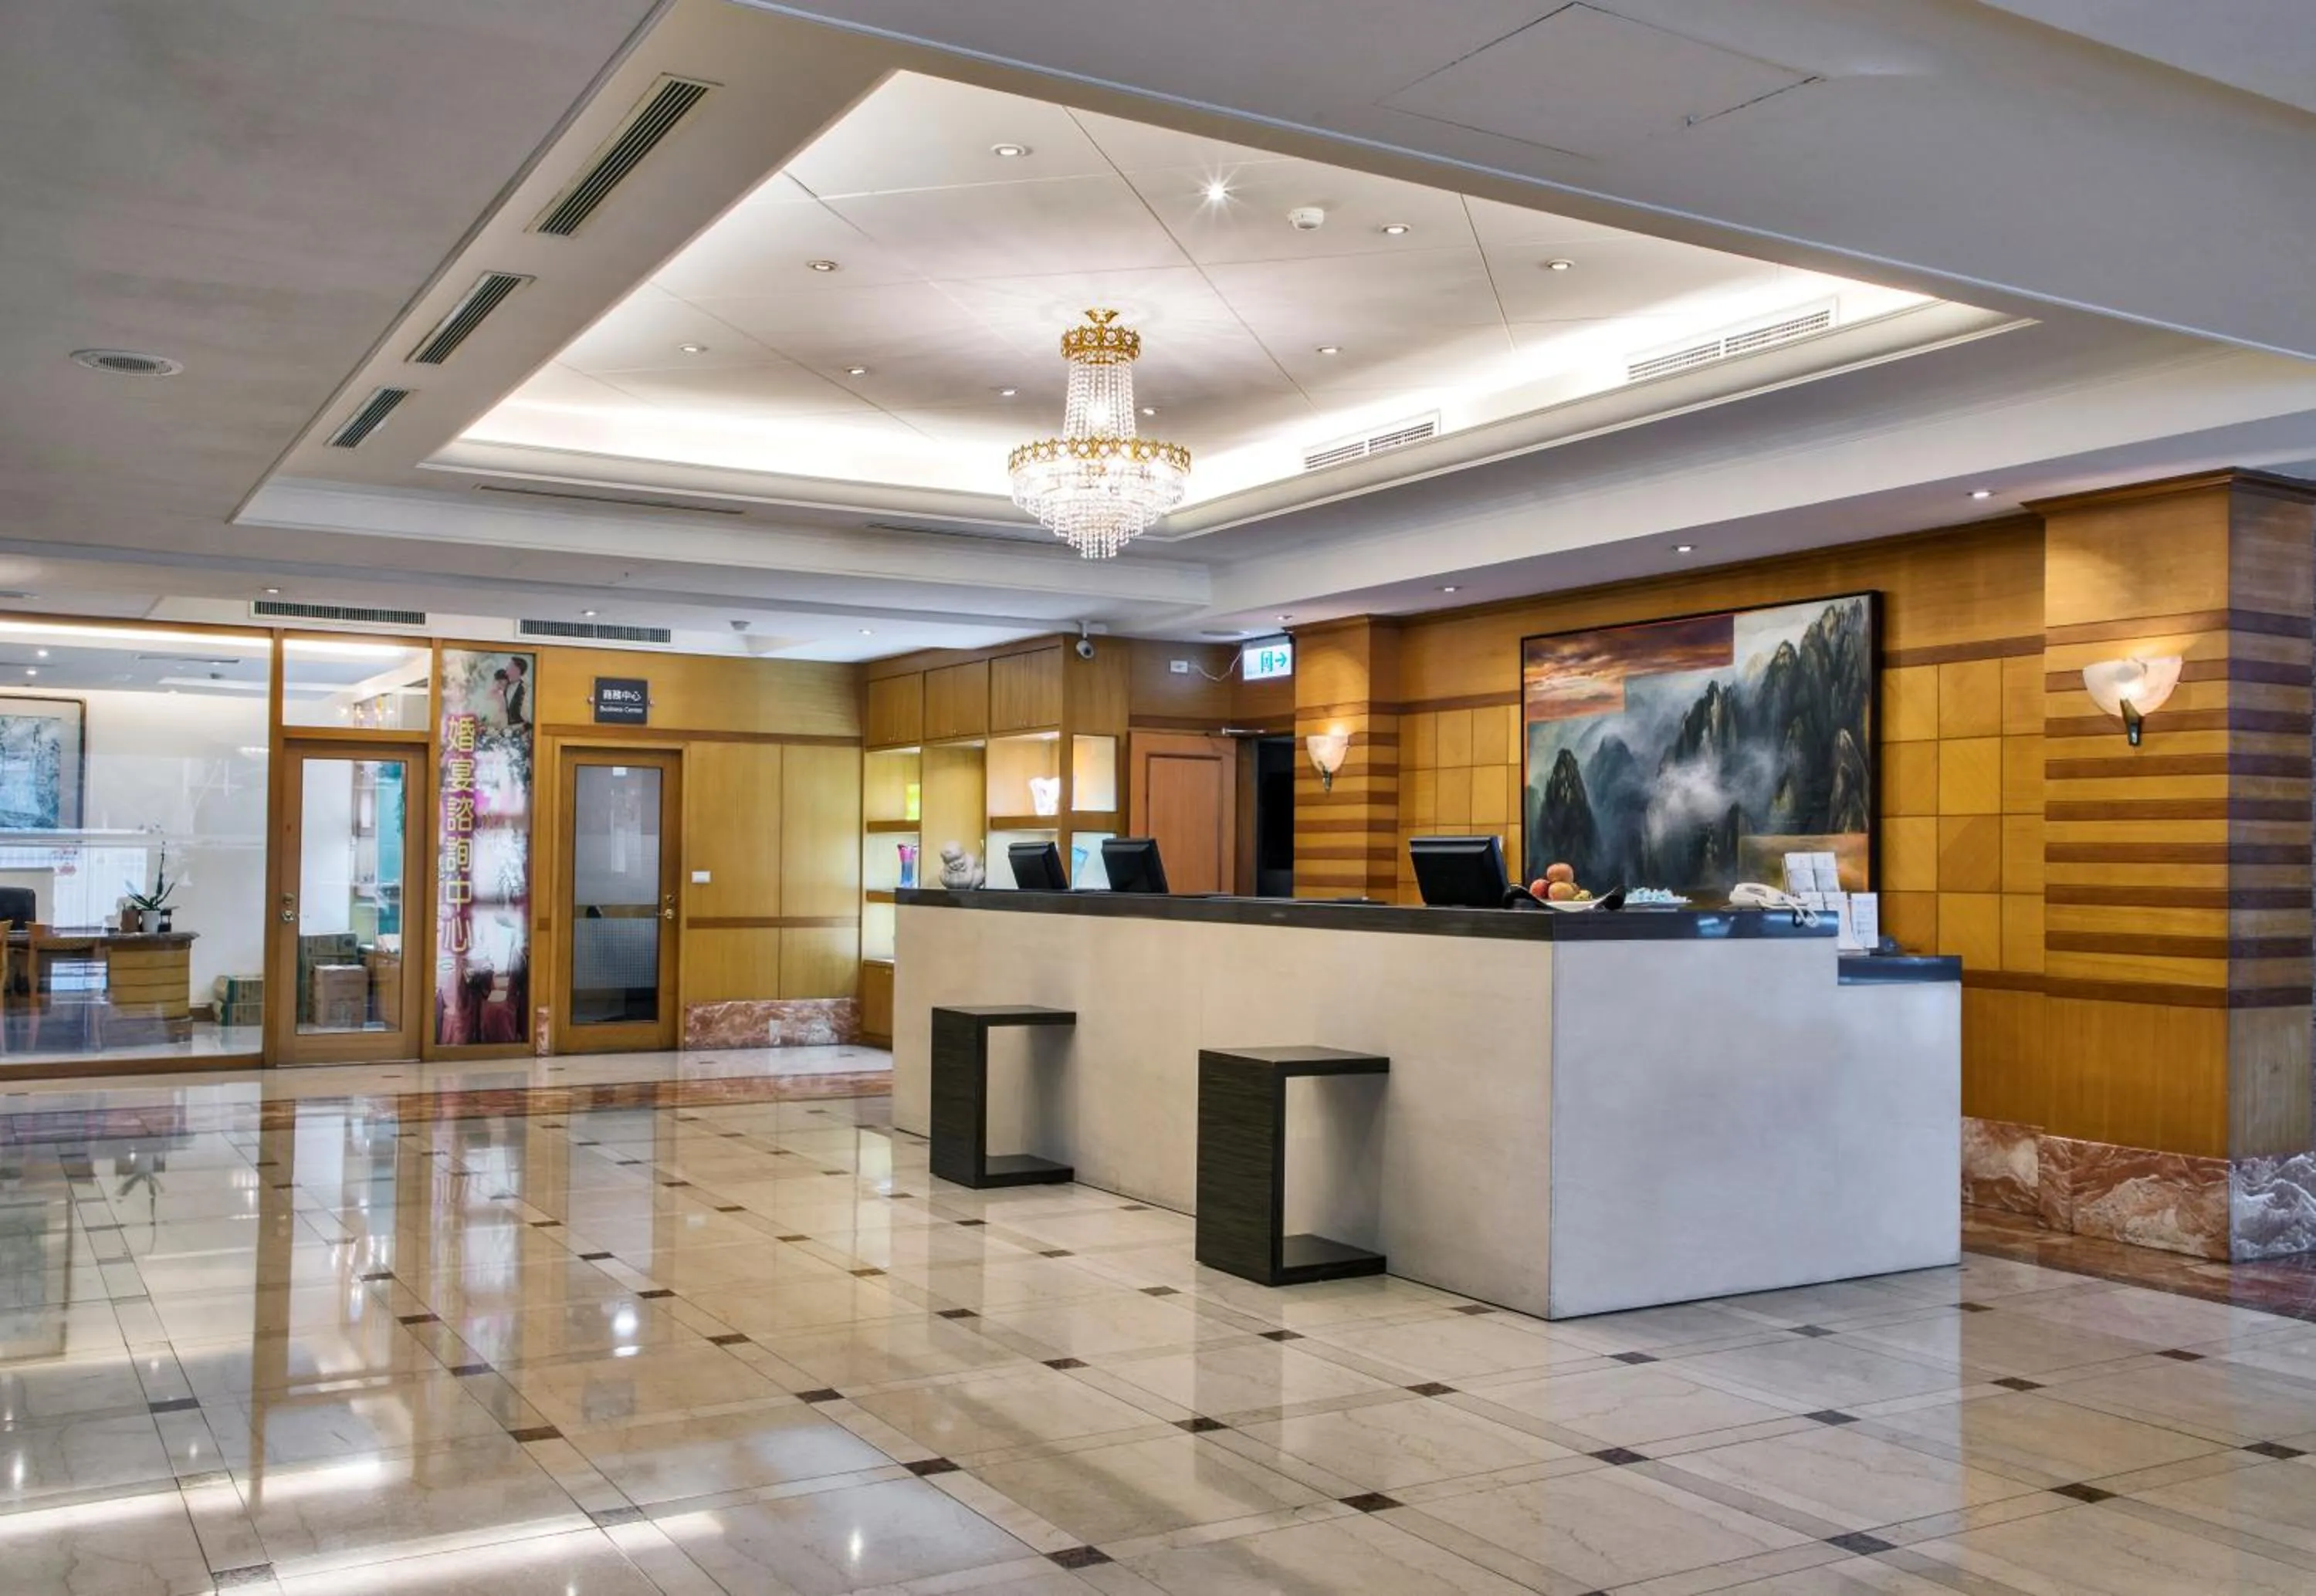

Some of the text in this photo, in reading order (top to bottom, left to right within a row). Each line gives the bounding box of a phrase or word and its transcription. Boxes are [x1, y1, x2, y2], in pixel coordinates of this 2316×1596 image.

[445, 715, 476, 953] 婚宴諮詢中心
